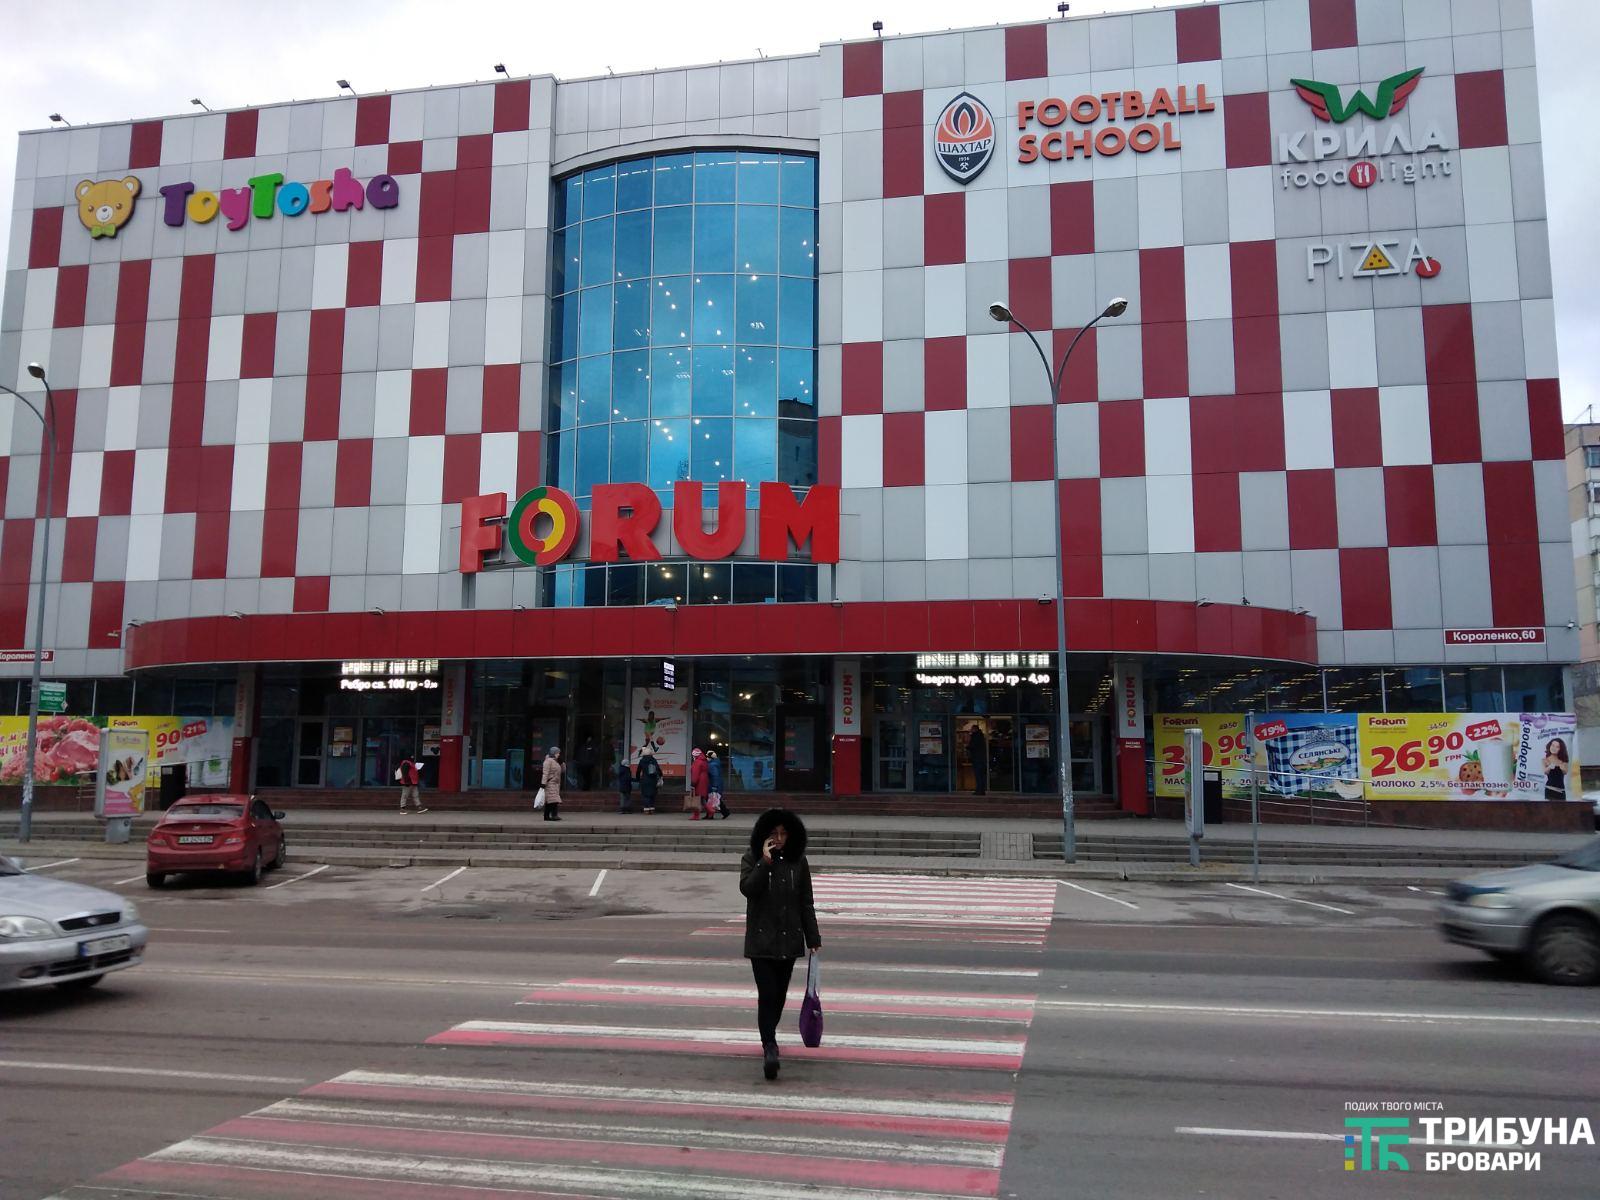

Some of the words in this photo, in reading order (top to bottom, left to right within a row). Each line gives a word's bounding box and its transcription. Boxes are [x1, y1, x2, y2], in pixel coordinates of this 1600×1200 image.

[1017, 84, 1215, 129] FOOTBALL
[938, 138, 991, 154] ШАХТАР
[1018, 121, 1182, 163] SCHOOL
[1278, 120, 1450, 164] КРИЛА
[1281, 163, 1348, 189] food
[1379, 155, 1452, 184] light
[160, 167, 399, 231] ToyTosha
[460, 481, 840, 573] FORUM
[1453, 630, 1536, 641] Короленко,60
[406, 681, 418, 690] гр
[916, 674, 956, 686] Чверть
[983, 673, 1004, 683] 100
[1006, 675, 1019, 686] гр
[843, 674, 853, 725] FORUM
[1126, 676, 1136, 727] FORUM
[1256, 723, 1285, 738] -19%
[1467, 724, 1500, 738] -22%
[1372, 780, 1416, 788] МОЛОКО
